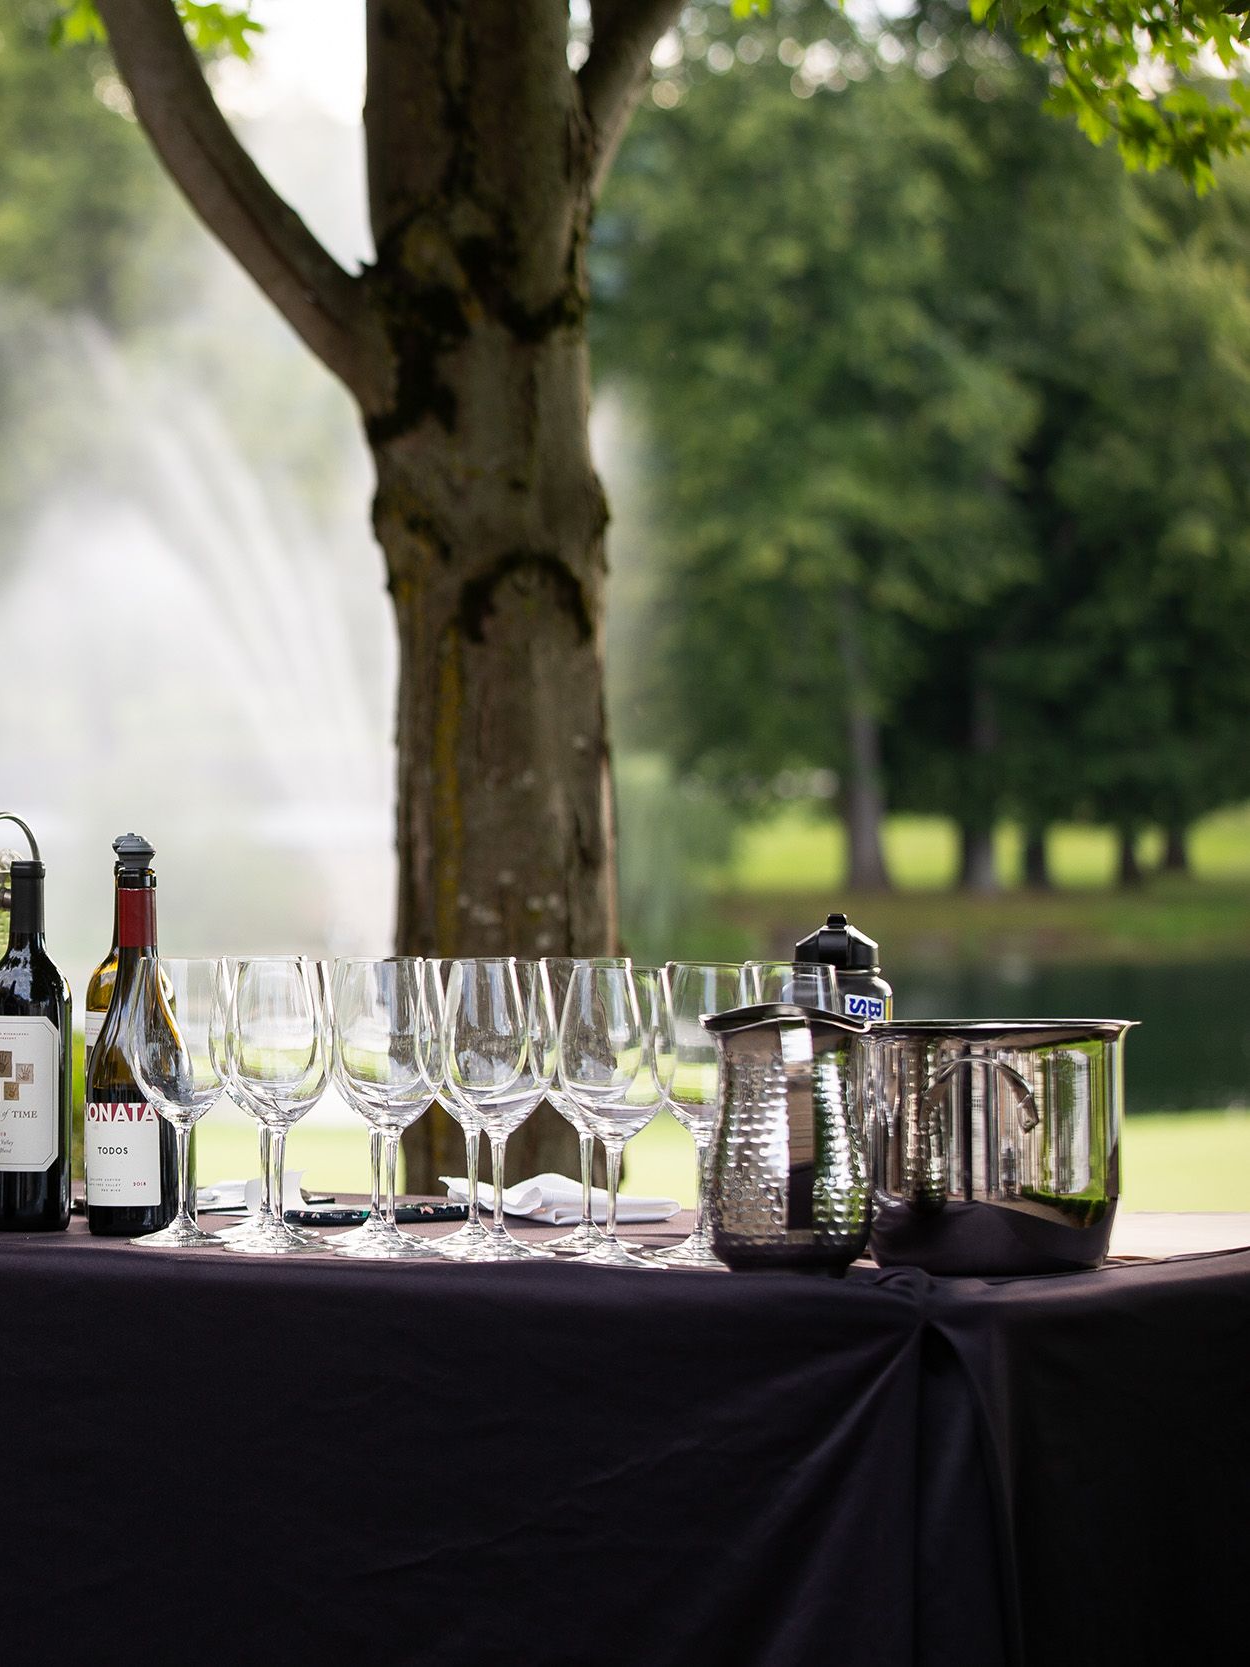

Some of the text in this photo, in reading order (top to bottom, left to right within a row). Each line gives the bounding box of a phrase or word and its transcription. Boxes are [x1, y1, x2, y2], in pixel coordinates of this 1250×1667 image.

[0, 1108, 10, 1122] of
[12, 1110, 38, 1118] TIME
[97, 1146, 128, 1155] TODOS
